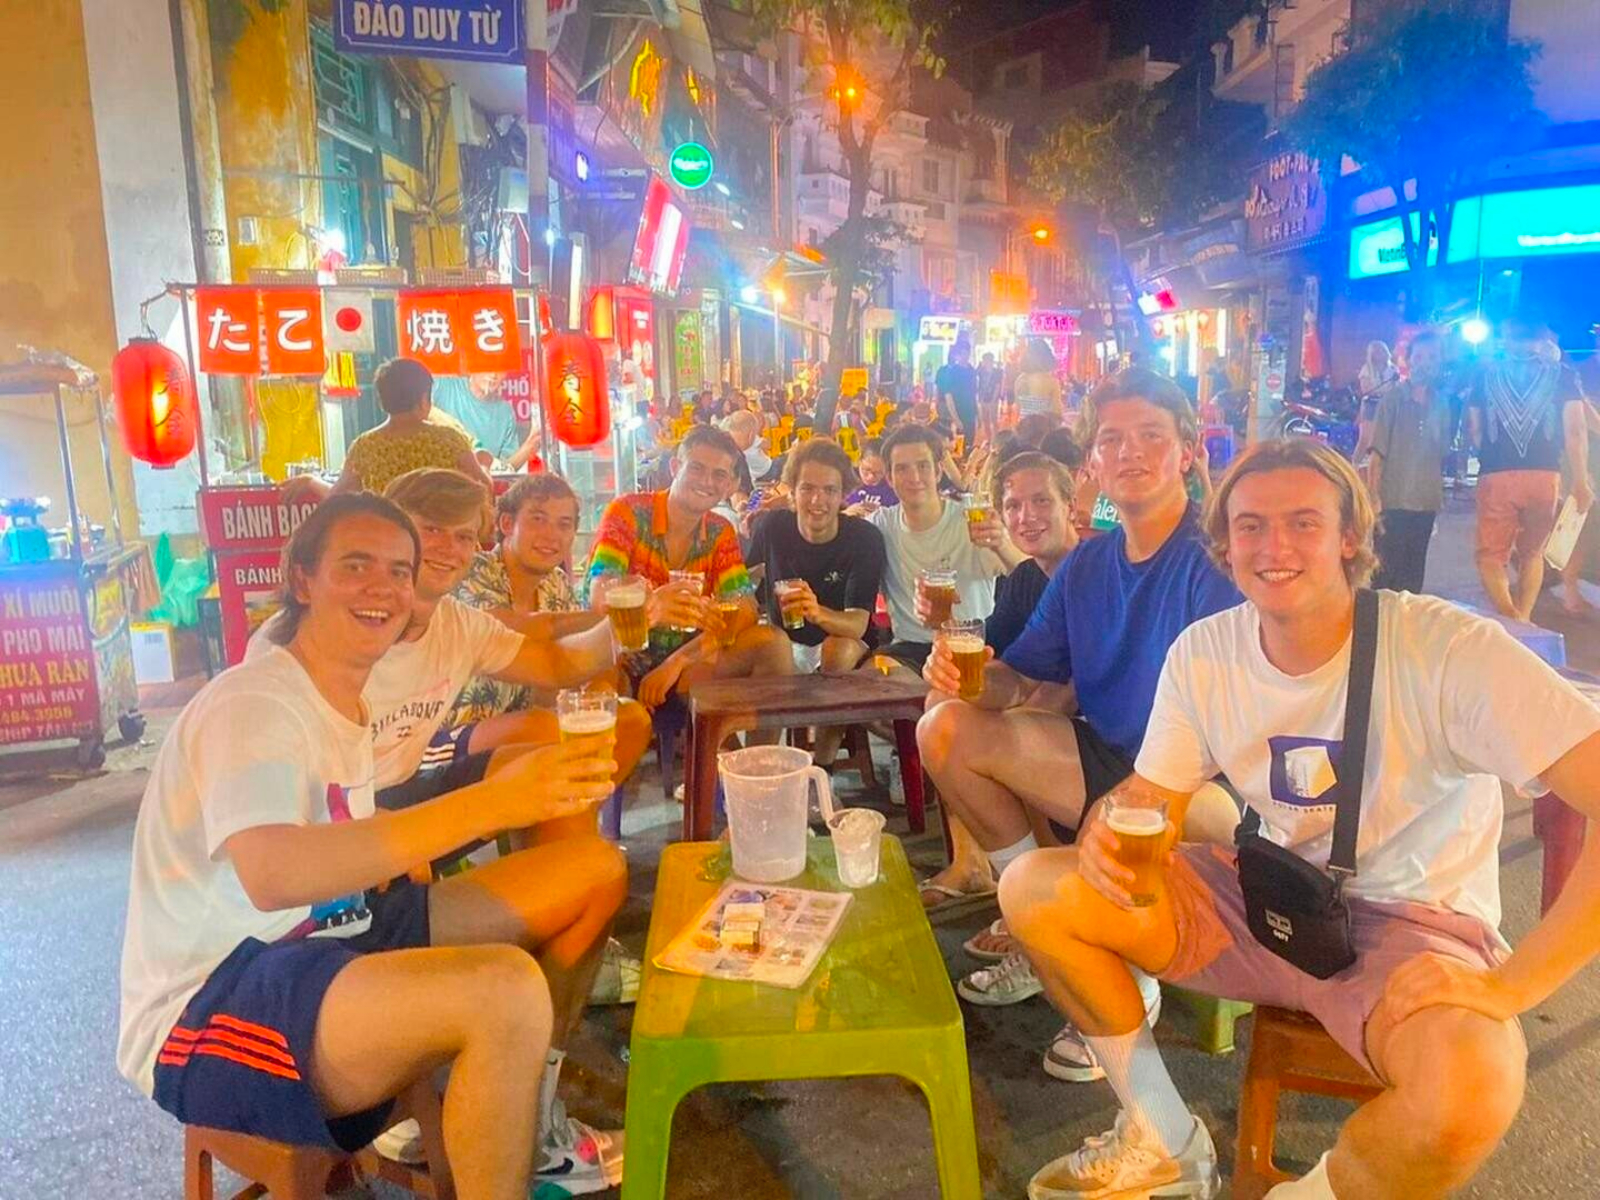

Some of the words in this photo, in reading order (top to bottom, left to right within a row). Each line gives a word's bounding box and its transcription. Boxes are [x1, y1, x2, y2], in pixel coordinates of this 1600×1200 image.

[413, 6, 461, 42] DUY
[468, 3, 502, 45] TỪ
[222, 500, 274, 540] BÁNH
[235, 563, 283, 586] BÁNH
[46, 653, 90, 685] RÁN
